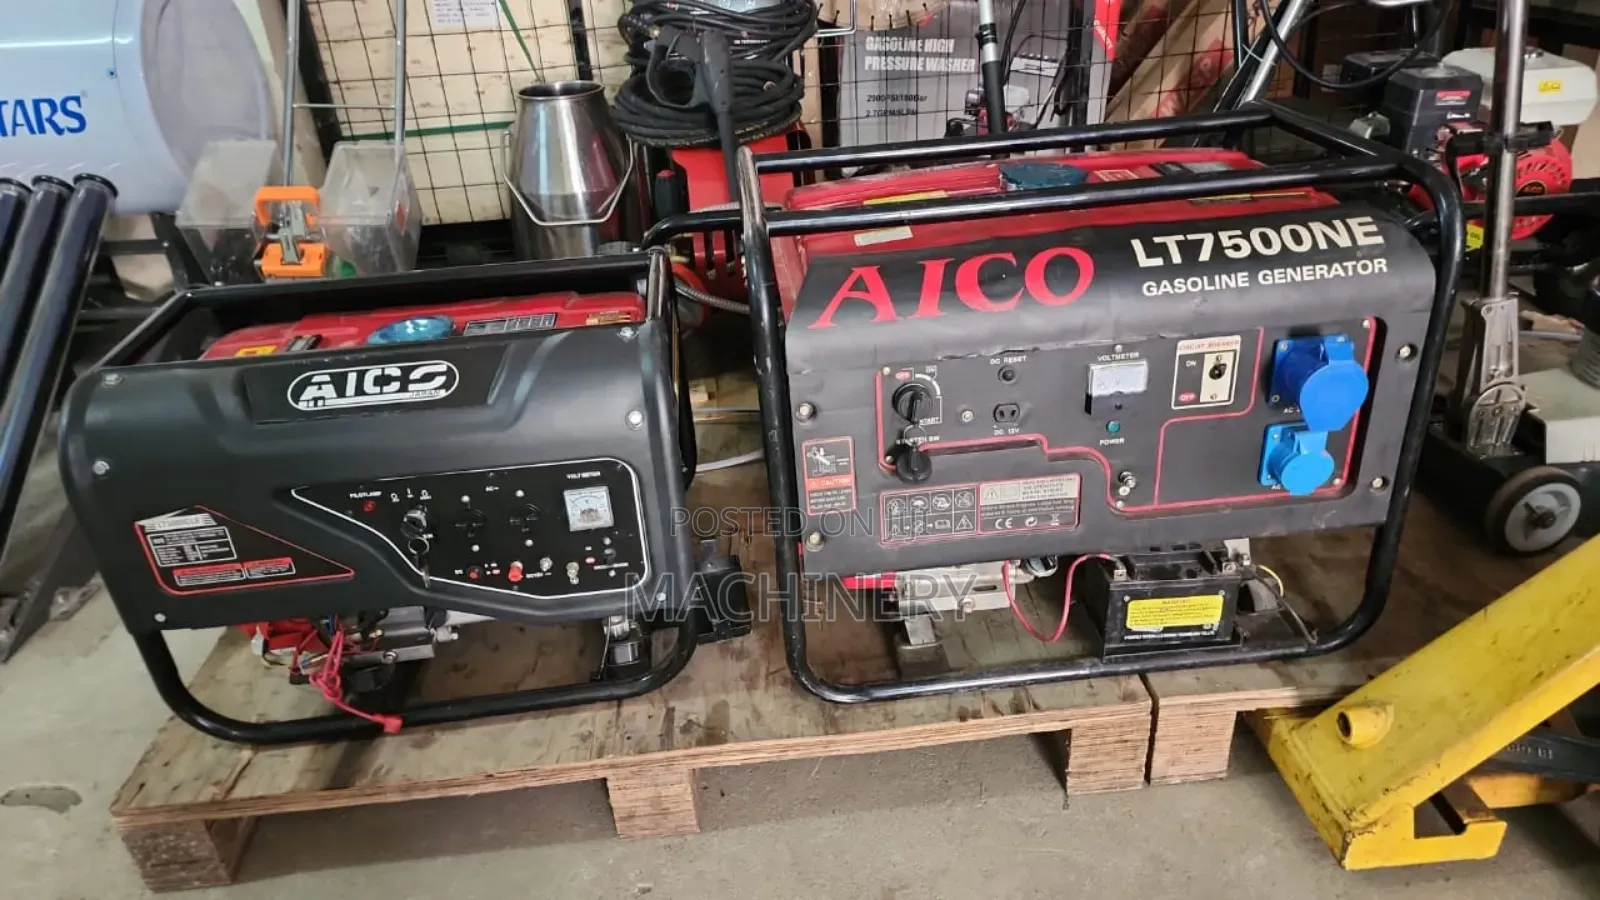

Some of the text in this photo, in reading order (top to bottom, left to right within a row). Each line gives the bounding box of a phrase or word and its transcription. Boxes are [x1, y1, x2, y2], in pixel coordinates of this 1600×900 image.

[865, 36, 955, 53] GASOLINE HIGH
[864, 55, 976, 72] PRESSURE WASHER
[1130, 215, 1385, 268] LT7500NE
[1142, 258, 1388, 297] GASOLINE GENERATOR
[806, 247, 1096, 330] AICO
[1003, 355, 1027, 364] RESET
[1097, 351, 1140, 362] VOLTMETER
[1099, 437, 1125, 446] POWER
